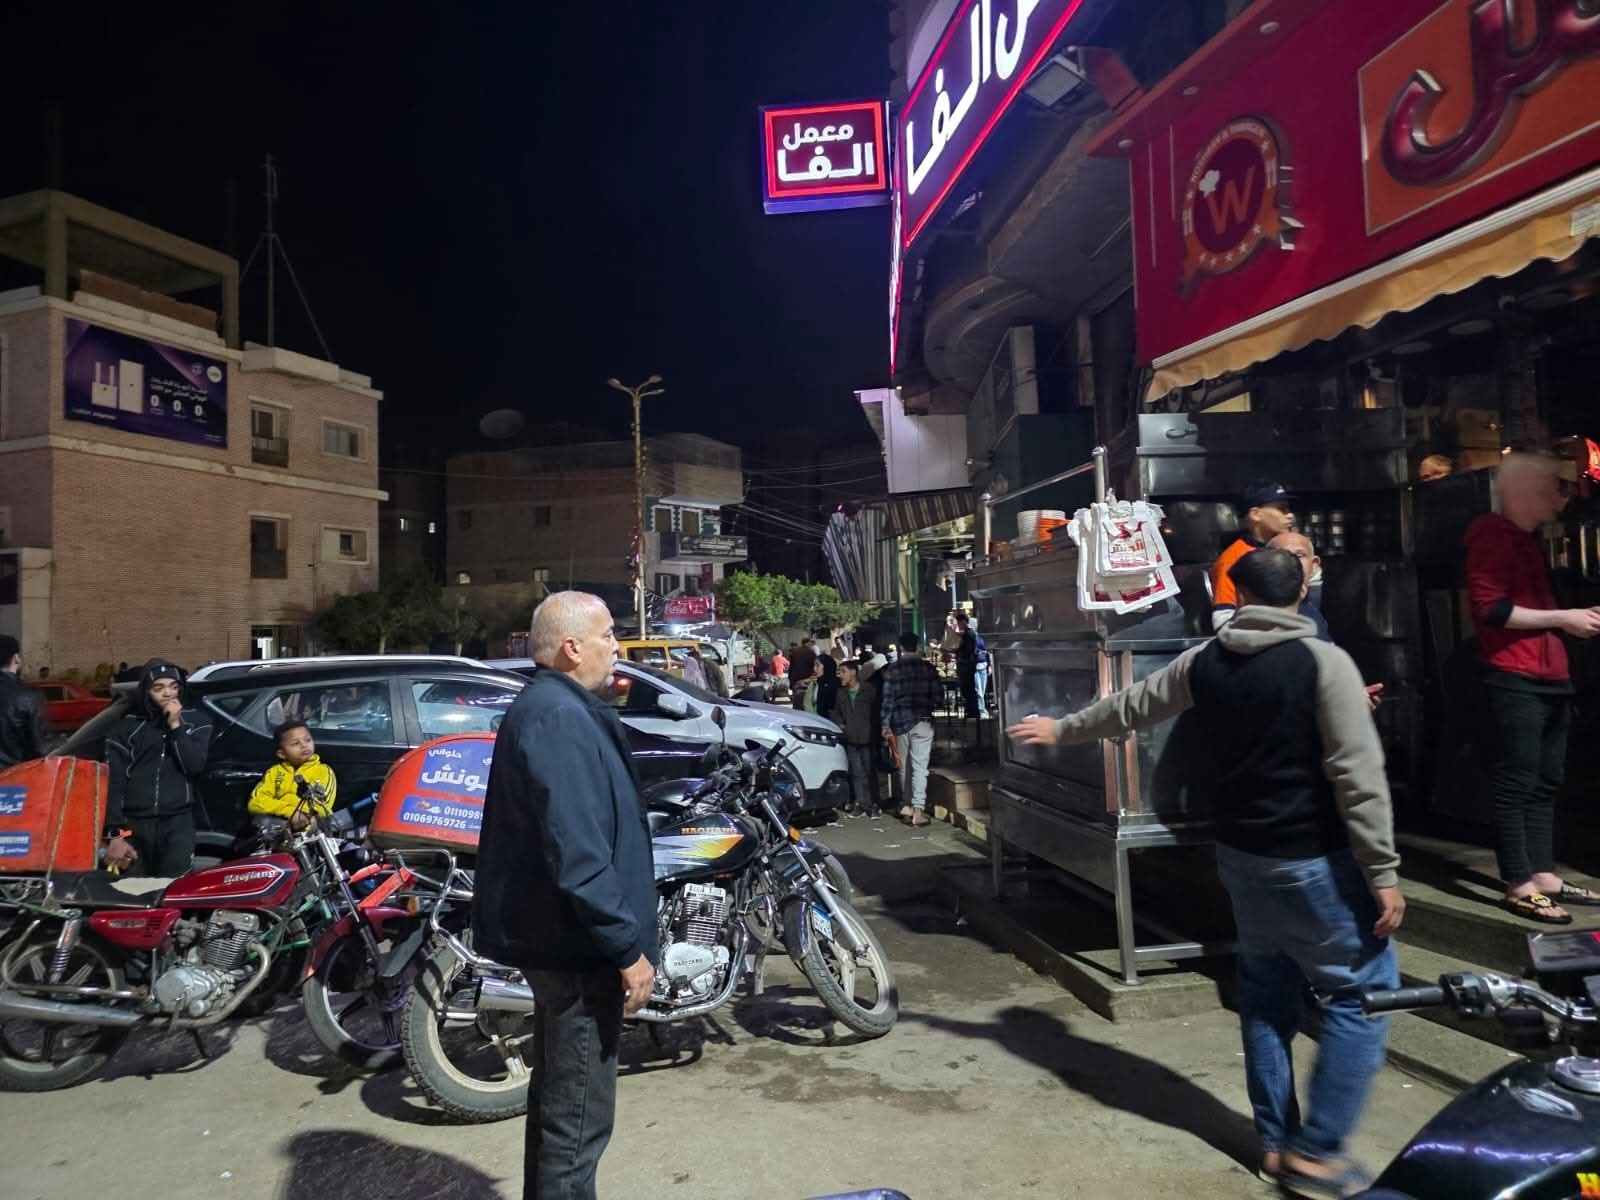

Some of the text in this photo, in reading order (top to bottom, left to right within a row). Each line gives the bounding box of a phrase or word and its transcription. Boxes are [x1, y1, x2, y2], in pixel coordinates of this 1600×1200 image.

[783, 122, 854, 151] معمل
[777, 142, 875, 182] الفا
[421, 764, 487, 792] ونش
[403, 812, 466, 829] 01069769726
